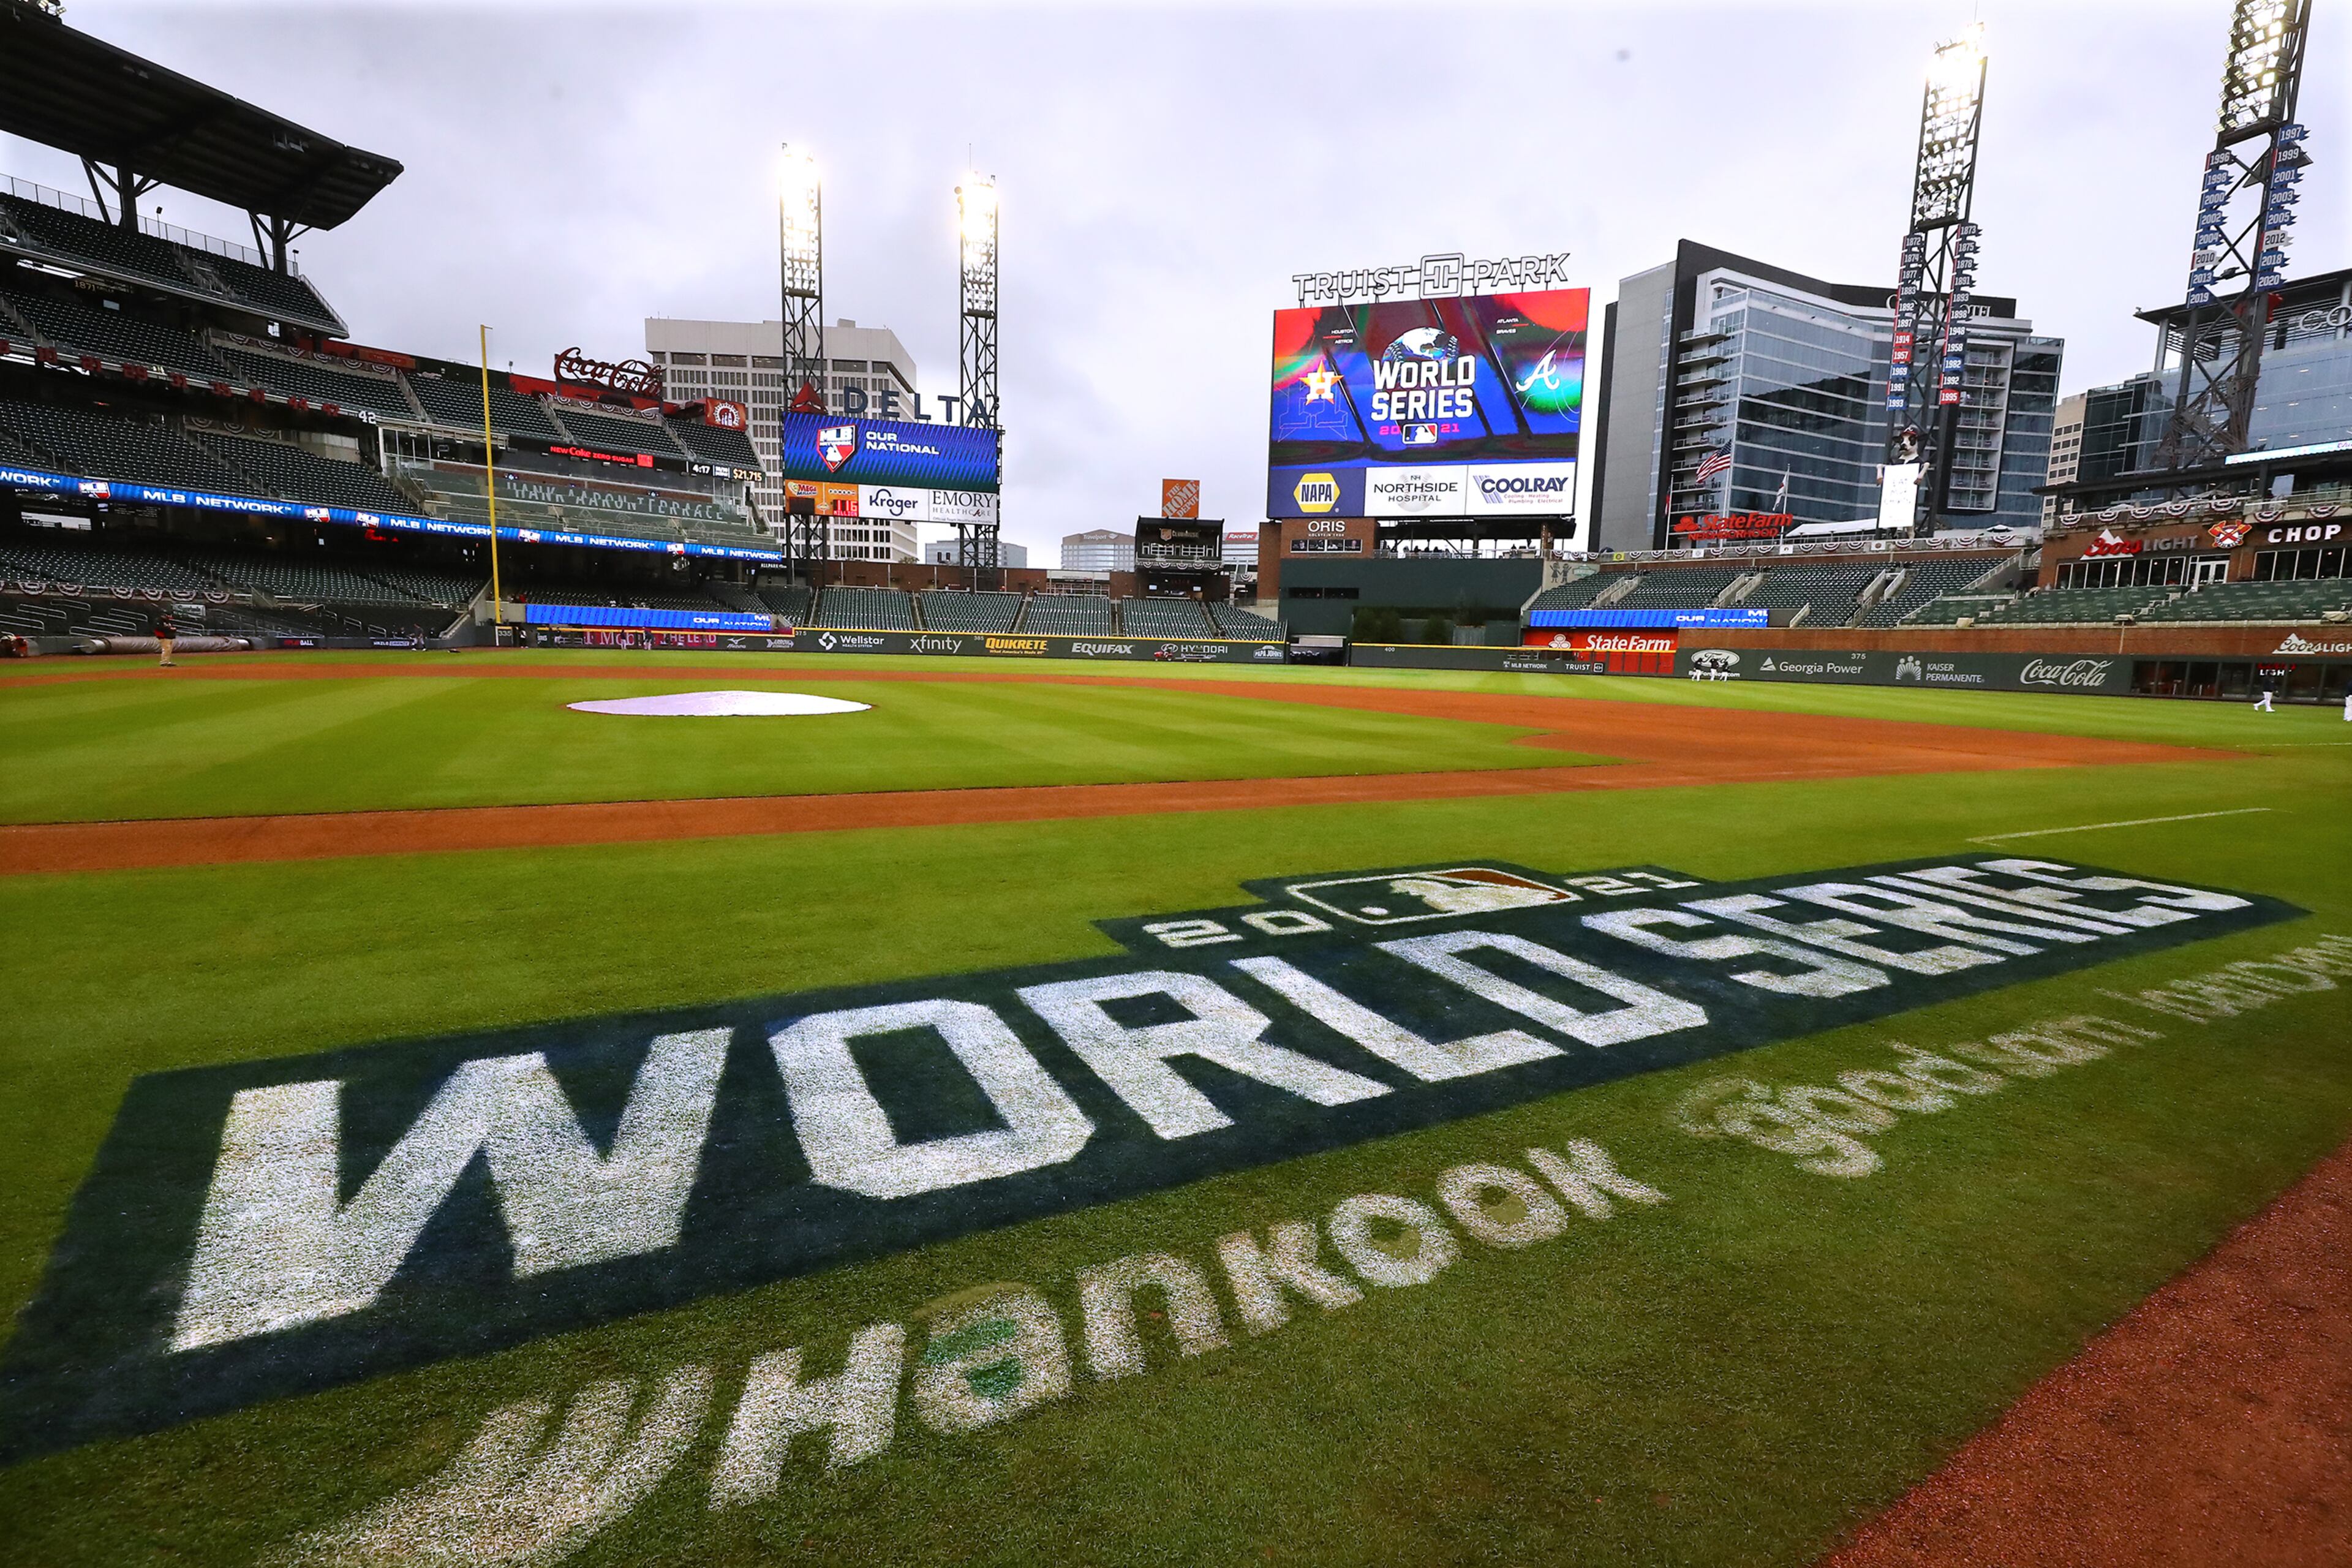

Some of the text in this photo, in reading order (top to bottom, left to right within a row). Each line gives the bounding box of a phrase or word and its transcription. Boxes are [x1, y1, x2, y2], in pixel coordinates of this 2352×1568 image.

[2280, 126, 2302, 141] 1997
[2211, 152, 2230, 165] 1996
[2277, 148, 2299, 162] 1999
[2207, 173, 2227, 185] 1998
[2274, 169, 2296, 183] 2001
[2205, 192, 2225, 205] 2000
[2272, 190, 2293, 203] 2003
[2202, 213, 2221, 224] 2002
[2268, 212, 2290, 225] 2005
[1961, 226, 1976, 235] 1873
[2199, 233, 2218, 245] 2004
[2265, 233, 2285, 245] 2012
[1959, 243, 1973, 252] 1875
[1957, 260, 1972, 268] 1878
[2196, 252, 2214, 265] 2010
[2262, 254, 2282, 266] 2018
[1292, 253, 1570, 300] TRUIST PARK
[1955, 277, 1970, 285] 1891
[2193, 272, 2212, 284] 2013
[2259, 274, 2279, 287] 2020
[2190, 293, 2209, 304] 2019
[1951, 310, 1967, 318] 1898
[1373, 354, 1476, 390] WORLD
[843, 386, 991, 429] DELTA
[1371, 388, 1474, 421] SERIES
[359, 410, 377, 425] 42
[1441, 423, 1460, 433] 21
[866, 431, 897, 442] OUR
[570, 447, 591, 458] Coke
[866, 441, 940, 455] NATIONAL
[692, 464, 710, 474] 4:17
[733, 468, 762, 481] $21,715
[1166, 483, 1182, 499] THE
[1374, 482, 1458, 494] NORTHSIDE
[1481, 477, 1569, 494] COOLRAY
[143, 490, 186, 503] MLB
[932, 491, 994, 508] EMORY
[1163, 480, 1199, 517] HOME
[1301, 484, 1333, 503] NAPA
[870, 489, 918, 516] Kroger
[1177, 494, 1199, 517] DEPOT
[933, 507, 991, 518] HEALTHCARE
[390, 519, 420, 529] MLB
[1307, 521, 1346, 533] ORIS
[556, 534, 584, 544] MLB
[1688, 528, 1780, 540] NEIGHBORHOOD
[2267, 524, 2342, 544] CHOP
[701, 548, 725, 556] MLB
[2085, 537, 2143, 557] Coors
[2144, 535, 2198, 551] LIGHT
[687, 635, 717, 643] LED
[840, 635, 884, 644] Wellstar
[910, 635, 962, 653] xfinity
[985, 638, 1048, 650] QUIKRETE
[1072, 642, 1133, 657] EQUIFAX
[1702, 652, 1730, 665] Frd
[1780, 662, 1863, 674] Georgia Power
[1927, 663, 1954, 671] KAISER
[1926, 674, 1982, 683] PERMANENTE
[1143, 872, 1705, 949] 20 21
[168, 857, 2253, 1355] WORLD SERIES
